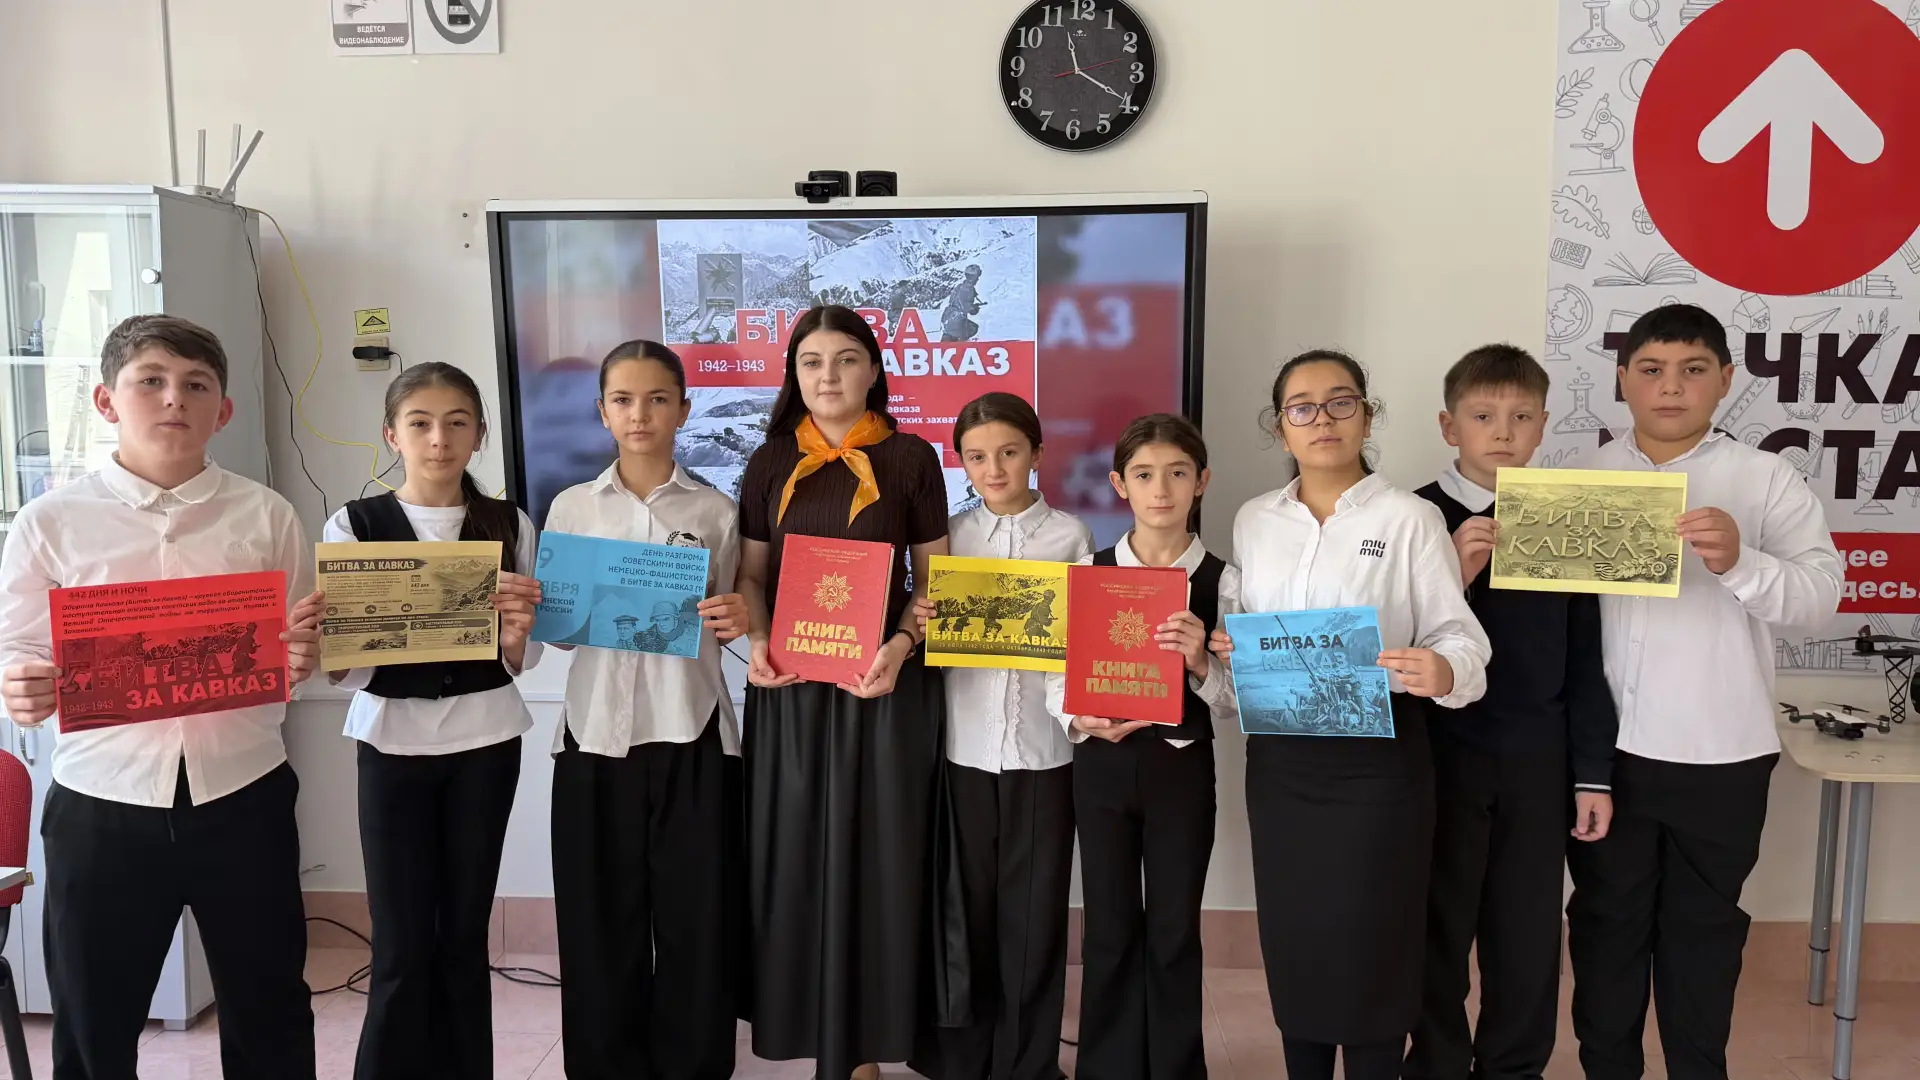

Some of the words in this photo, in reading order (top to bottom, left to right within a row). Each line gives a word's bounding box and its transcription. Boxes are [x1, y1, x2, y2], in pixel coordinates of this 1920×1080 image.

[1041, 5, 1064, 27] 11
[1070, 0, 1096, 20] 12
[1102, 8, 1115, 30] 1
[339, 36, 405, 45] ВИДЕОНАБЛЮДЕНИЕ
[1016, 26, 1043, 48] 10
[1123, 32, 1138, 53] 2
[1011, 55, 1025, 77] 9
[1129, 62, 1145, 83] 3
[1018, 87, 1033, 108] 8
[1119, 92, 1135, 114] 4
[1039, 110, 1055, 131] 7
[1066, 119, 1081, 141] 6
[1096, 112, 1111, 134] 5
[735, 307, 929, 344] БИВА
[1040, 297, 1137, 349] АЗ
[883, 347, 1010, 377] АВКАЗ
[887, 405, 920, 413] авказа
[888, 395, 904, 403] ода
[925, 416, 958, 424] захват
[1516, 509, 1656, 530] БИТВА
[1567, 527, 1602, 537] ЗА
[642, 549, 663, 557] ДЕНЬ
[665, 551, 704, 561] РАЗГРОМА
[1507, 535, 1662, 560] КАВКАЗ
[326, 562, 360, 571] БИТВА
[363, 561, 377, 570] ЗА
[378, 560, 415, 570] КАВКАЗ
[622, 556, 674, 568] СОВЕТСКИМИ
[608, 565, 704, 582] НЕМЕЦКО-ФАШИСТСКИХ
[120, 586, 148, 595] НОЧИ
[541, 580, 580, 595] ЯБРЯ
[627, 578, 652, 587] БИТВЕ
[665, 582, 694, 591] КАВКАЗ
[541, 597, 575, 606] ИНСКОЙ
[794, 620, 858, 641] КНИГА
[932, 630, 981, 642] БИТВА
[985, 633, 1004, 643] ЗА
[785, 637, 863, 660] ПАМЯТИ
[1259, 636, 1316, 650] БИТВА
[1320, 634, 1345, 648] ЗА
[91, 653, 226, 690] БИТВА
[1092, 660, 1161, 680] КНИГА
[126, 687, 163, 710] ЗА
[171, 672, 277, 704] КАВКАЗ
[1086, 677, 1168, 699] ПАМЯТИ
